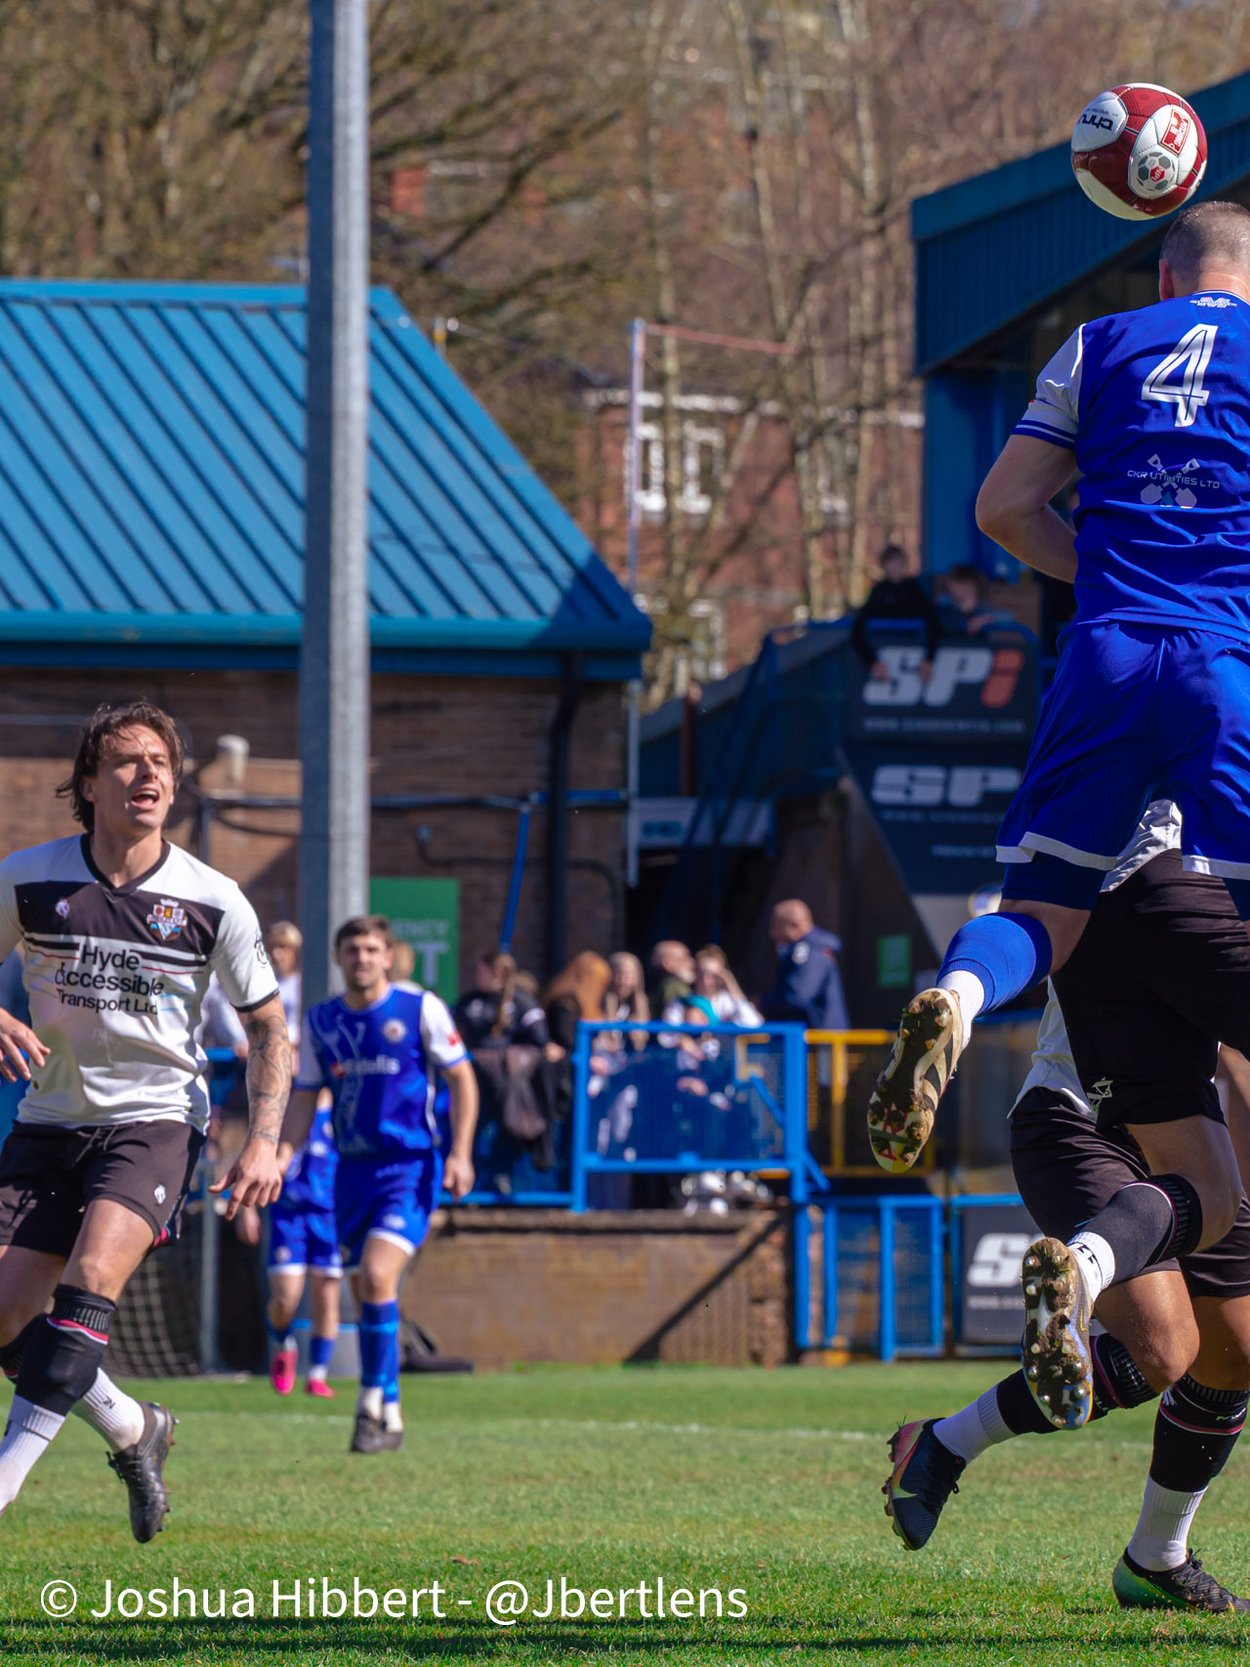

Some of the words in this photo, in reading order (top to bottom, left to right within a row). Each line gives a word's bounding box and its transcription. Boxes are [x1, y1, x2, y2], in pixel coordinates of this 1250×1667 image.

[1141, 323, 1218, 427] 4
[1127, 469, 1147, 479] CKR
[1150, 471, 1198, 486] UTILITIES
[1200, 479, 1220, 489] LTD
[81, 944, 140, 971] Hyde
[57, 988, 131, 1013] Transport
[134, 997, 158, 1015] Ltd
